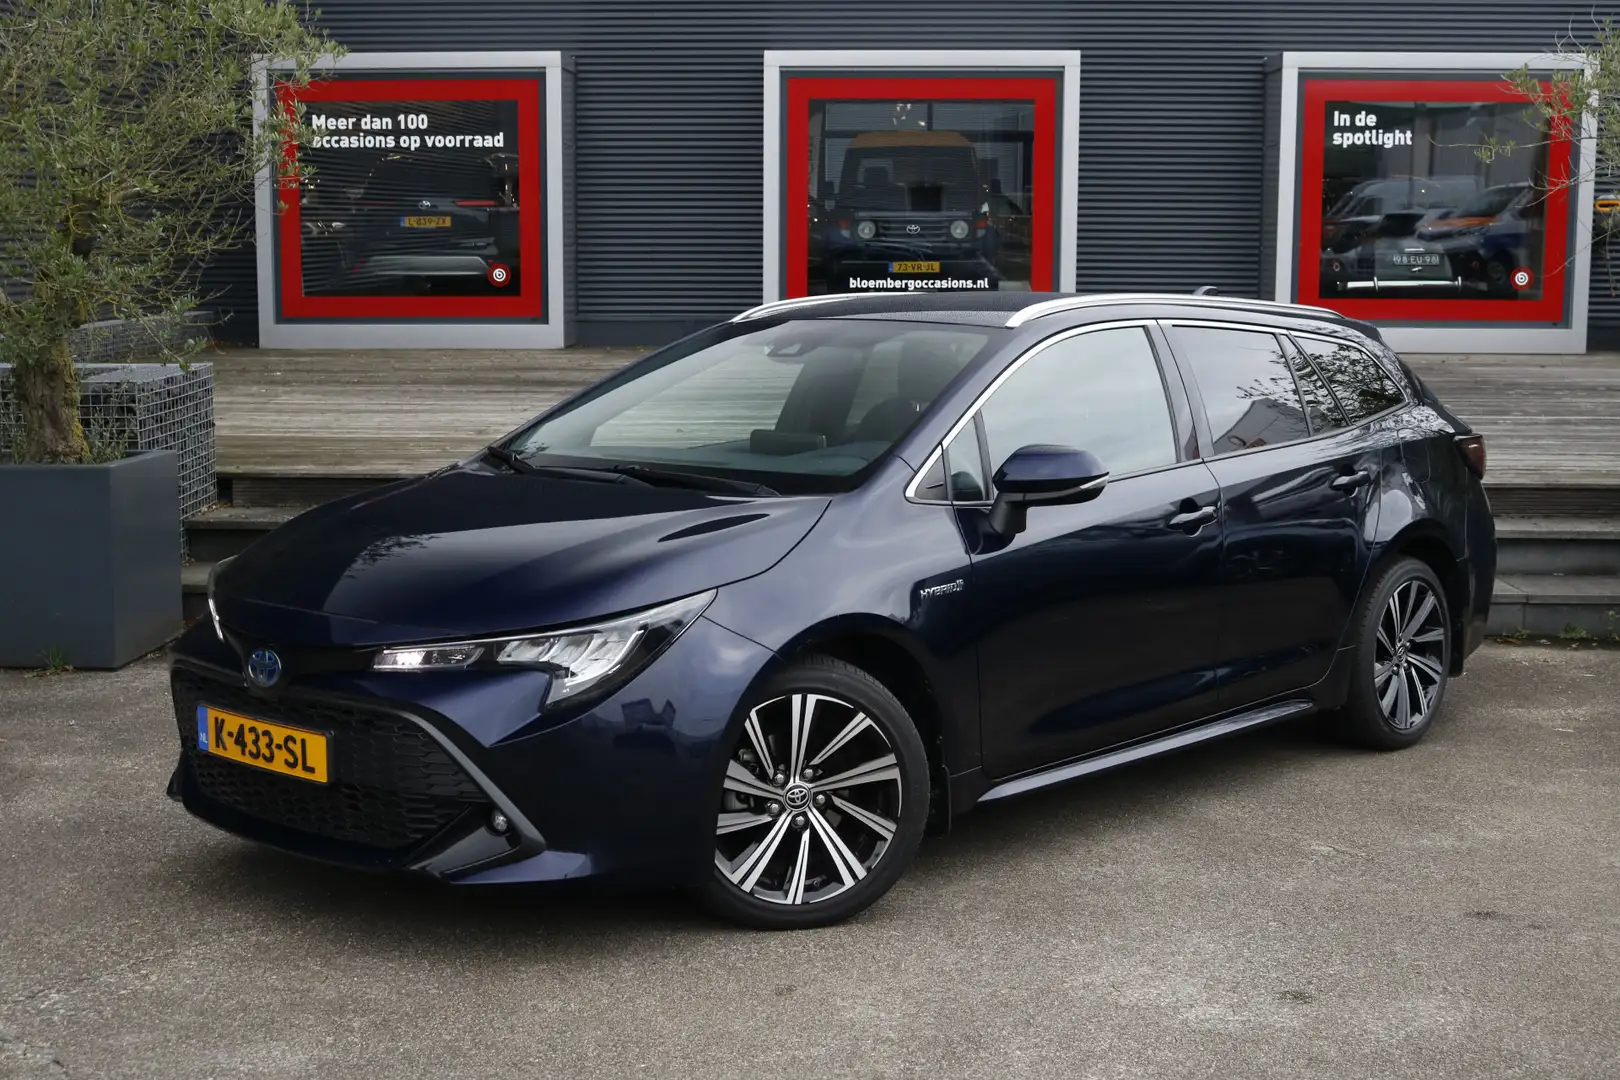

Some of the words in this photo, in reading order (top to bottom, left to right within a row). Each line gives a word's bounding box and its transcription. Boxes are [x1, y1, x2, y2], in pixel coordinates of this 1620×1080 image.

[311, 114, 357, 130] Meer
[360, 114, 392, 130] dan
[397, 113, 428, 130] 100
[1333, 110, 1351, 127] In
[1354, 110, 1377, 127] de
[312, 132, 396, 148] occasions
[399, 135, 421, 151] op
[424, 131, 504, 148] voorraad
[1332, 129, 1413, 149] spotlight
[849, 277, 990, 291] bloembergoccasions.nl
[920, 582, 957, 600] HYBRID
[199, 731, 208, 744] NL
[214, 716, 316, 774] K-433-SL
